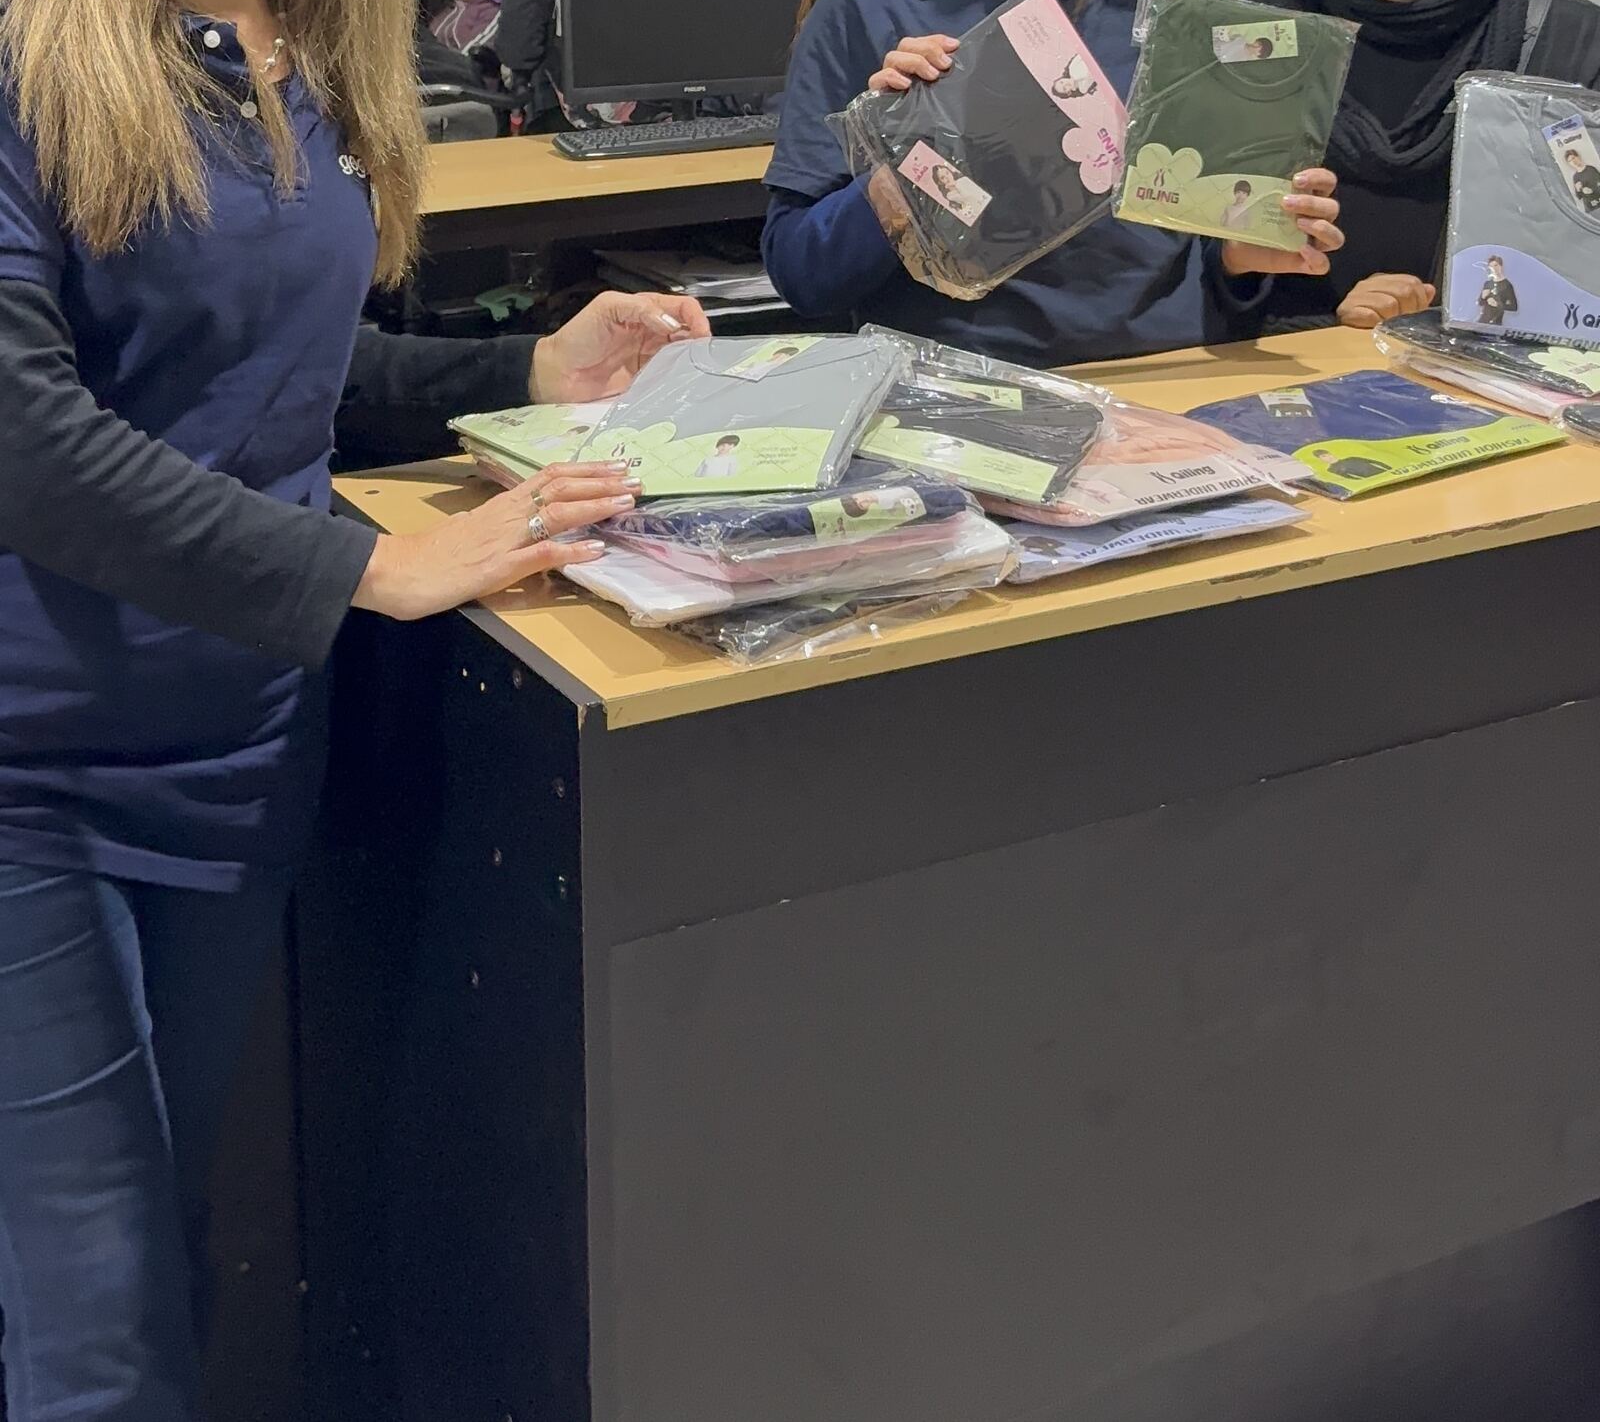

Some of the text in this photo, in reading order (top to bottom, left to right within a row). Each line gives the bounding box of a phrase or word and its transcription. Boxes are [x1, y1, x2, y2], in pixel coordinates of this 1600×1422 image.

[1135, 186, 1181, 205] QILING
[1391, 436, 1531, 476] FASHION UNDERWEAR
[1134, 482, 1219, 506] UNDERWEAR
